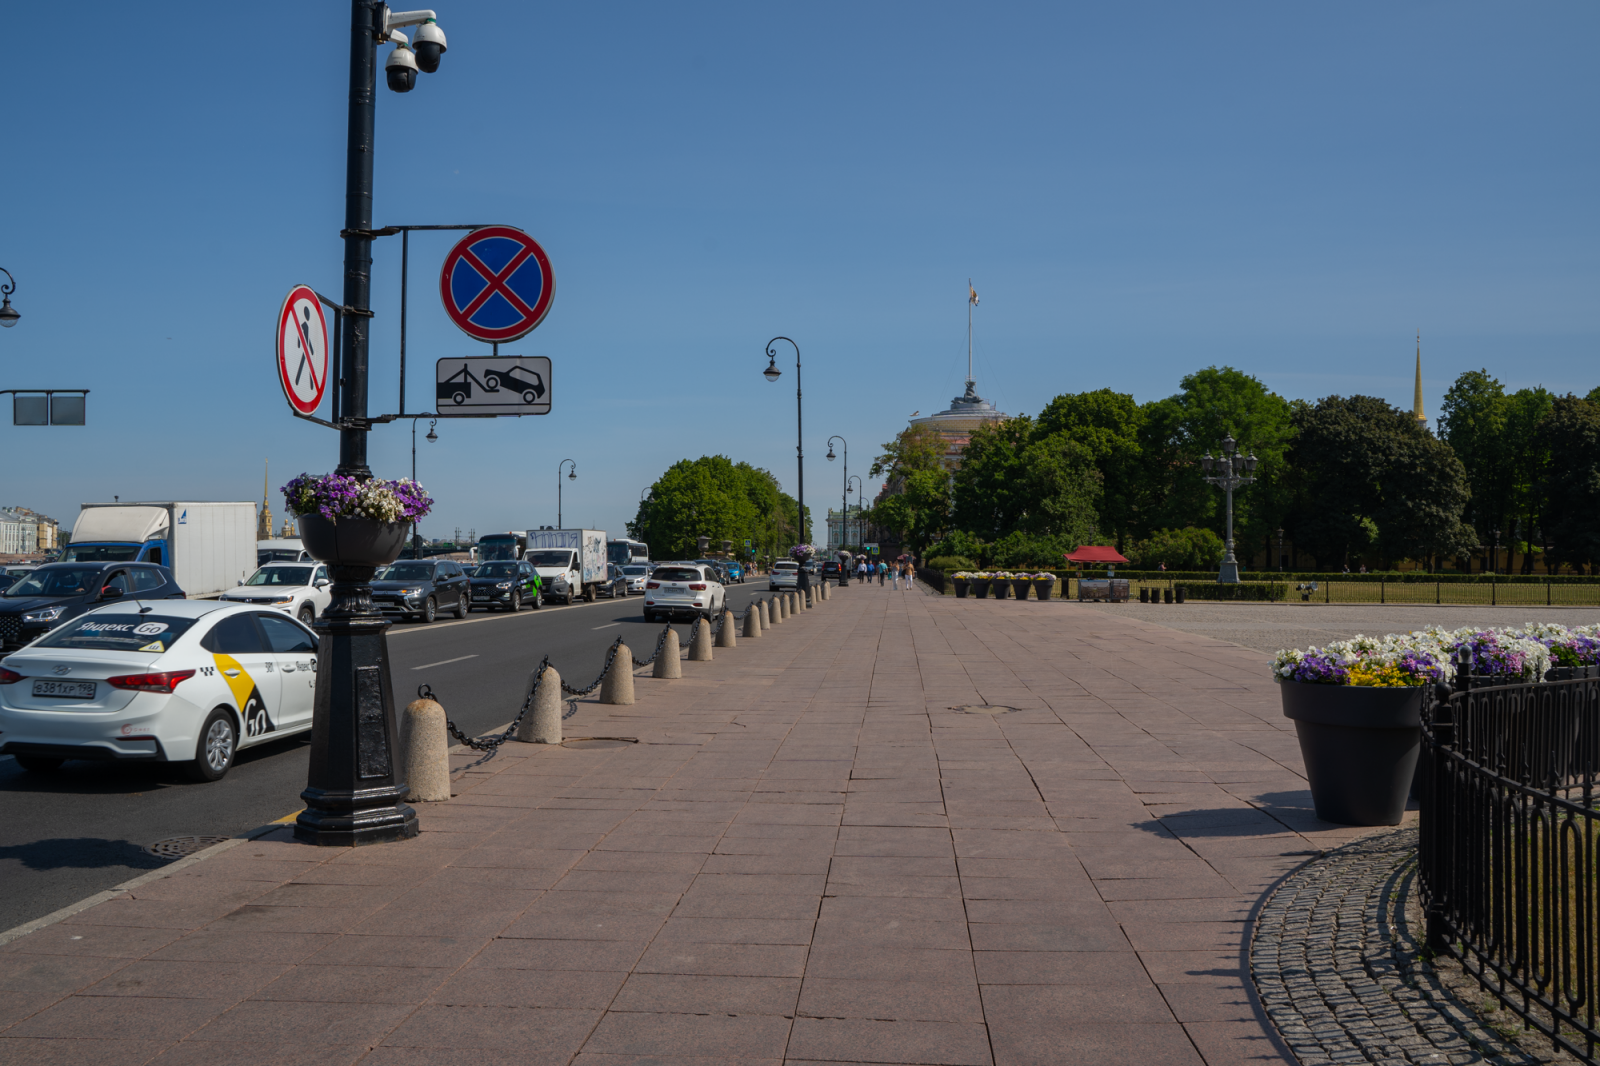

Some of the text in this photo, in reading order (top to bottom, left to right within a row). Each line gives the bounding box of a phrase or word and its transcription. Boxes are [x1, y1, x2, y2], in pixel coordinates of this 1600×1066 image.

[75, 621, 161, 634] Яндекс Go
[244, 698, 267, 737] Go
